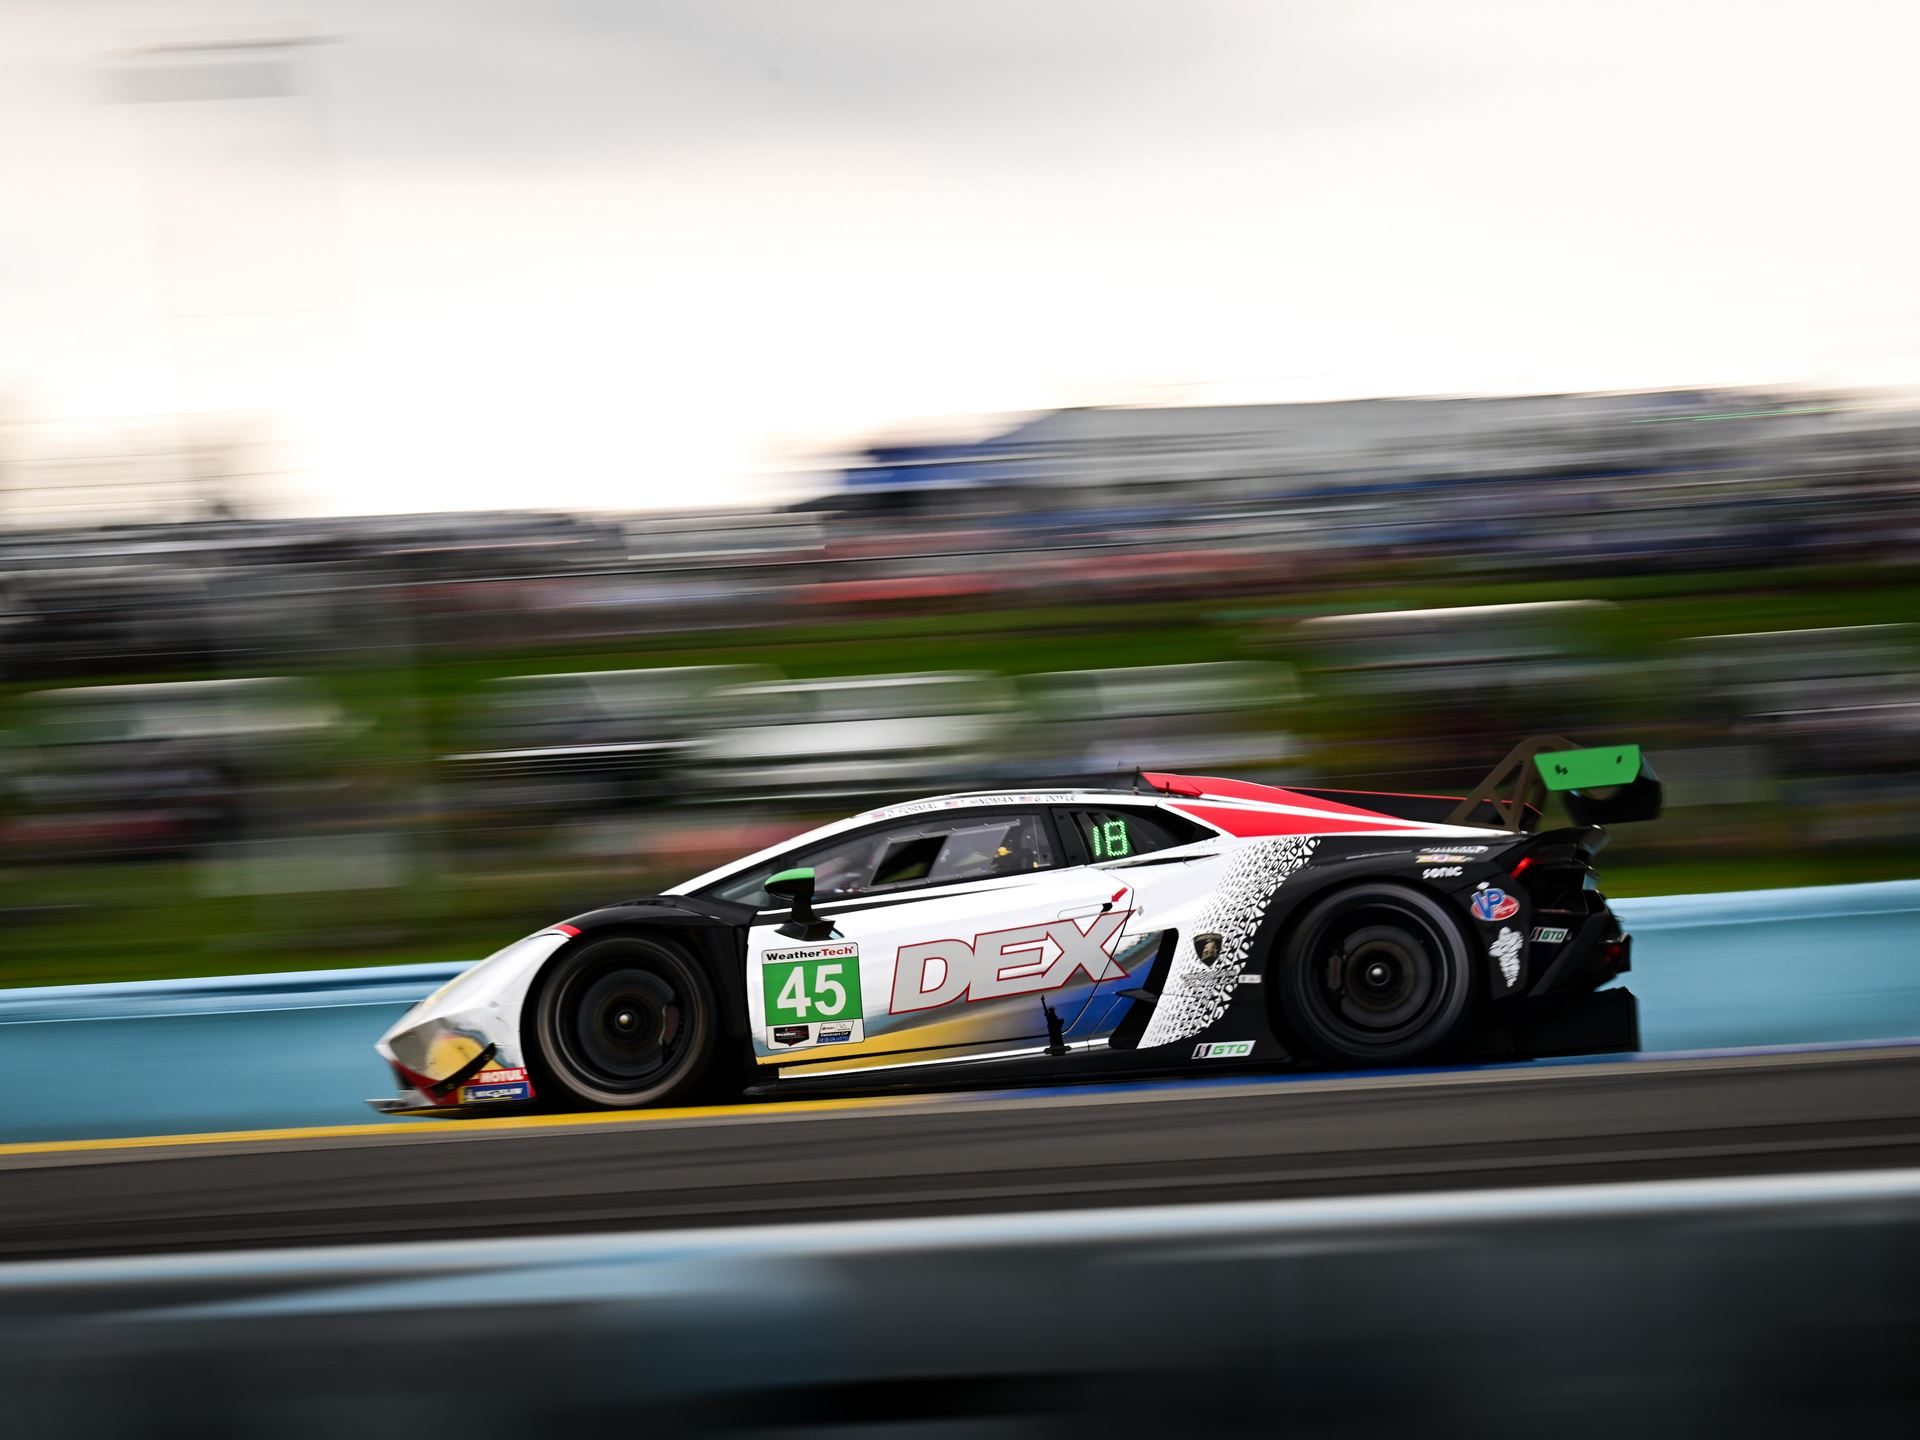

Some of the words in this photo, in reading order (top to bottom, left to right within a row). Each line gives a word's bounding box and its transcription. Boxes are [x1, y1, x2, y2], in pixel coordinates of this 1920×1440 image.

[1093, 820, 1128, 857] 18
[1541, 930, 1565, 940] GTD
[766, 946, 854, 961] WeatherTech
[888, 909, 1137, 1016] DEX
[776, 963, 847, 1018] 45
[1212, 1043, 1249, 1055] GTD
